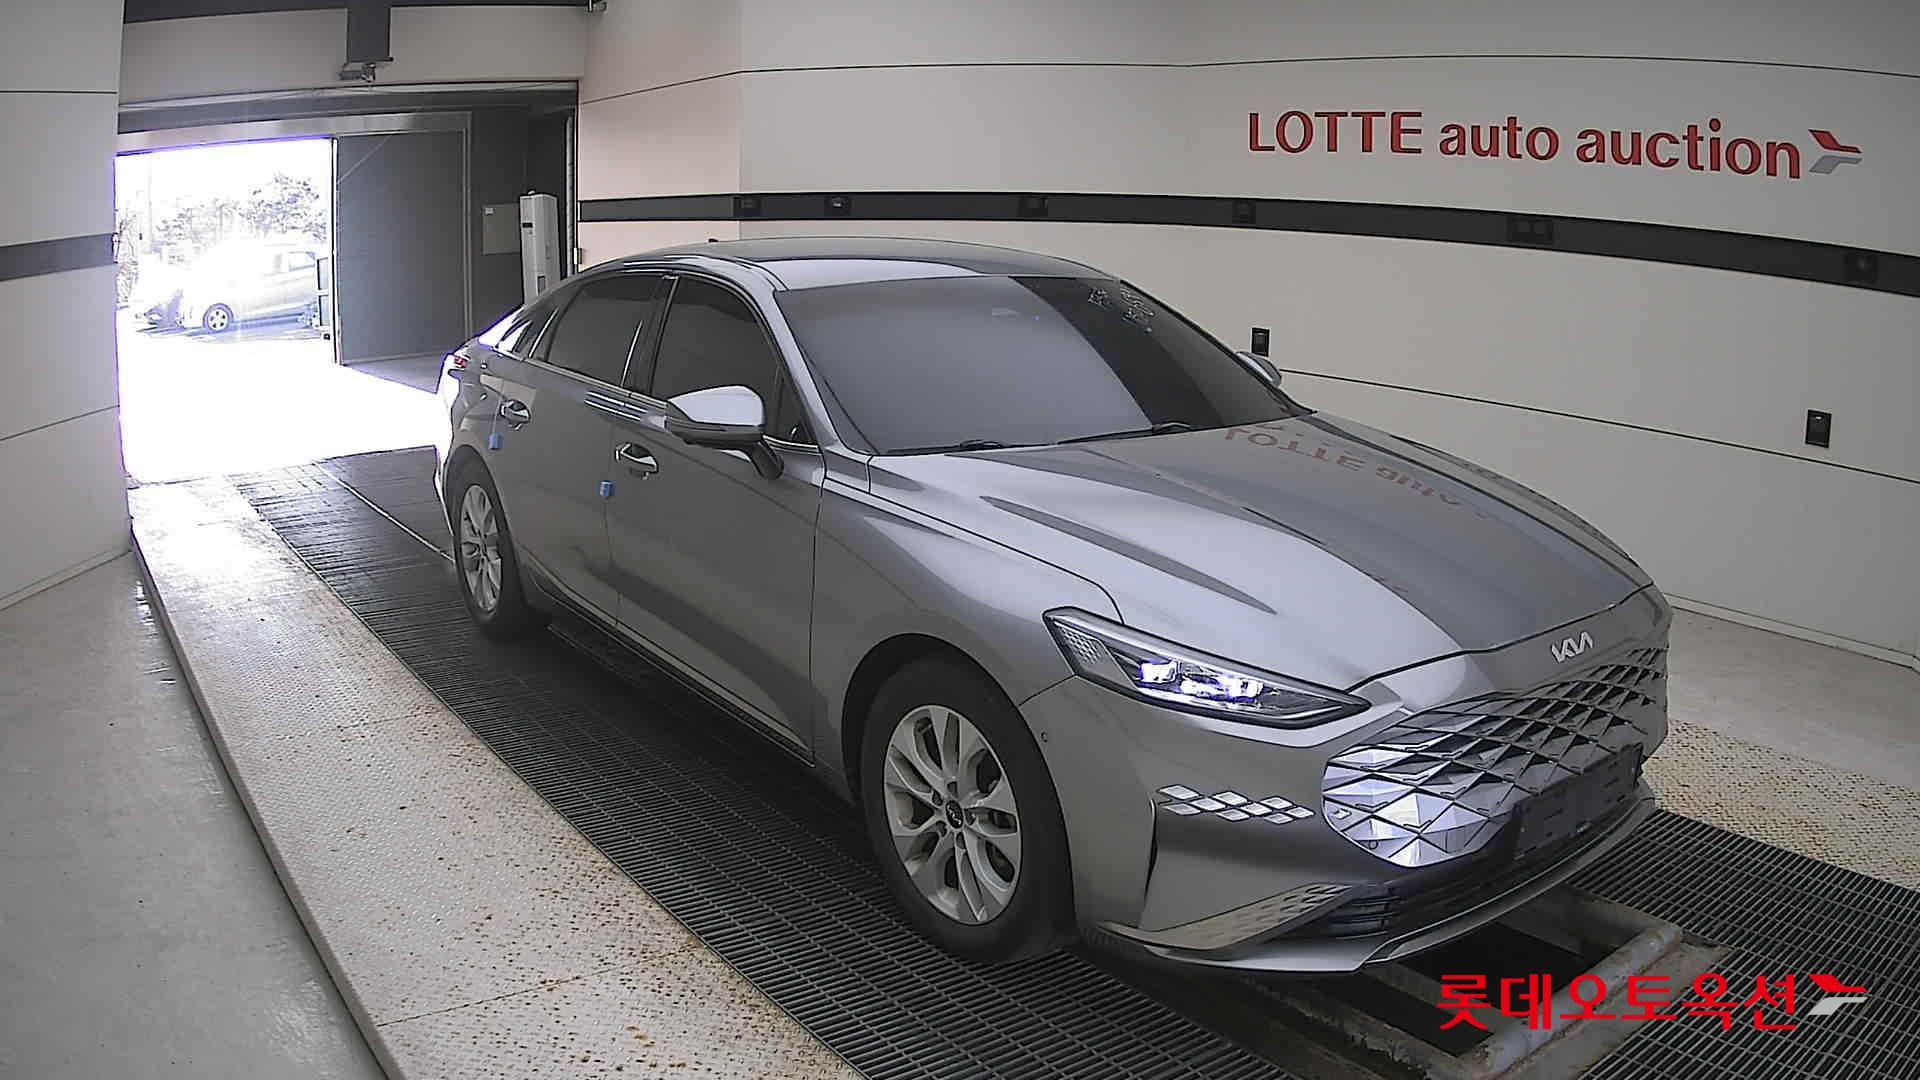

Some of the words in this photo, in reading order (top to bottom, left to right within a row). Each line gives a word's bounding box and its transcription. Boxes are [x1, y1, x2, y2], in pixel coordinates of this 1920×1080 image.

[1248, 111, 1423, 154] LOTTE
[1439, 116, 1559, 161] auto
[1576, 117, 1801, 179] auction
